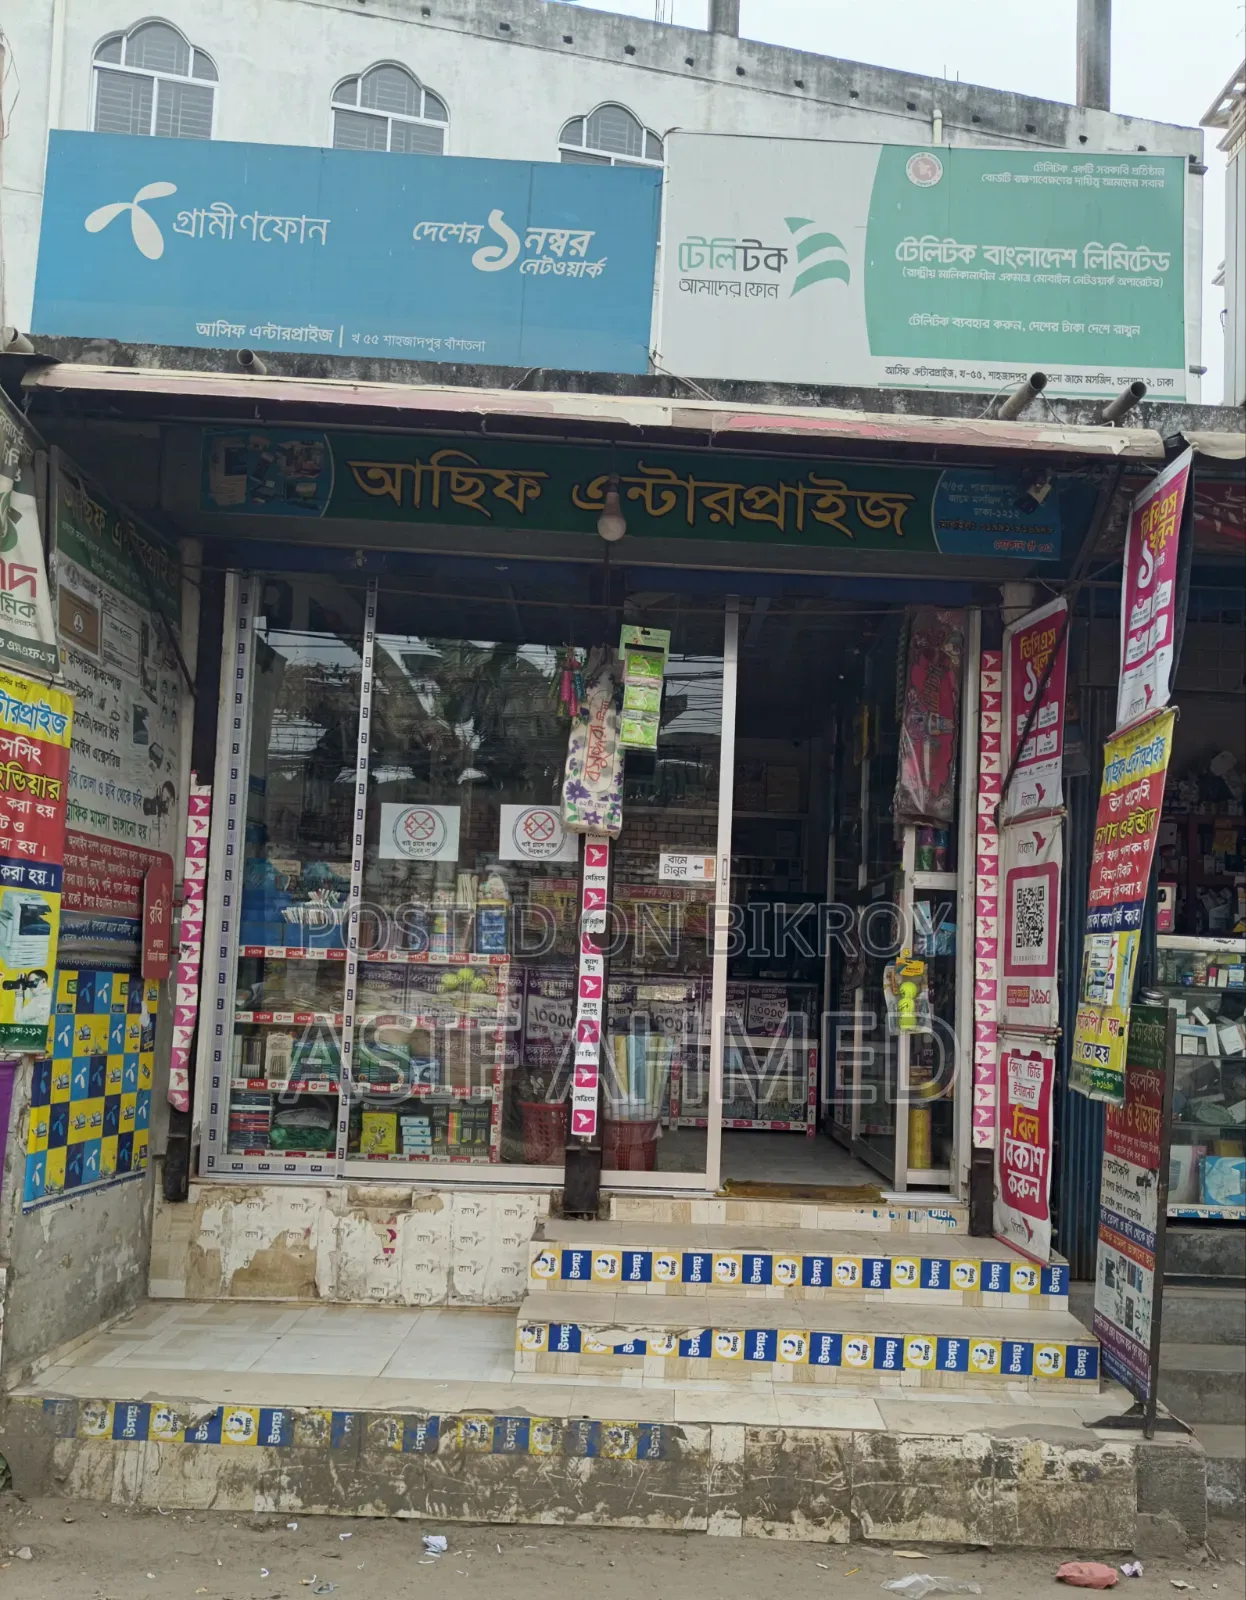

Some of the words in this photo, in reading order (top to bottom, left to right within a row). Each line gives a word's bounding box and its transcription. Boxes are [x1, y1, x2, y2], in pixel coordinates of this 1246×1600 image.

[173, 202, 331, 246] গ্রামীণফোন
[413, 221, 484, 244] দেশের
[472, 209, 520, 272] ১
[525, 227, 595, 258] নম্বর
[520, 256, 607, 278] নেটওয়ার্ক
[678, 236, 788, 274] টেলিটক
[896, 236, 976, 263] টেলিটক
[983, 246, 1077, 272] বাংলাদেশ
[1082, 242, 1170, 277] লিমিটেড
[679, 278, 742, 298] আমাদের
[745, 282, 780, 300] ফোন
[1033, 275, 1070, 286] মোবাইল
[195, 319, 246, 339] আসিফ
[249, 322, 334, 345] এন্টারপ্রাইজ
[382, 335, 442, 353] শাহজাদপুর
[908, 314, 949, 328] টেলিটক
[952, 318, 990, 330] ব্যবহার
[993, 319, 1026, 333] করুন,
[1028, 320, 1059, 333] দেশের
[1061, 320, 1085, 333] টাকা
[1087, 323, 1111, 335] দেশে
[1113, 325, 1141, 339] রাখুন
[885, 363, 910, 375] আসিফ
[1065, 374, 1083, 386] জামে
[1085, 375, 1115, 388] মসজিদ,
[345, 448, 551, 520] আছিফ
[571, 460, 916, 540] এন্টারপ্রাইজ
[1020, 628, 1057, 661] ডিপিএস
[79, 774, 97, 794] তোলা
[105, 780, 116, 801] ছবি
[117, 788, 132, 805] থেকে
[7, 796, 32, 814] করা
[36, 802, 57, 820] হয়
[89, 808, 111, 832] মামলা
[13, 821, 26, 833] ও
[16, 839, 38, 856] হয়
[667, 855, 688, 865] বামে
[0, 864, 25, 883] করা
[28, 867, 48, 886] হয়
[664, 863, 688, 877] টানুন
[149, 898, 163, 925] রবি
[1130, 1069, 1161, 1098] প্রসেসিং
[1012, 1103, 1039, 1145] বিল
[1003, 1128, 1045, 1177] বিকাশ
[1007, 1166, 1040, 1204] করুন
[570, 1253, 584, 1279] উপায়
[630, 1254, 645, 1280] উপায়
[690, 1256, 705, 1283] উপায়
[751, 1257, 766, 1283] উপায়
[811, 1259, 826, 1285] উপায়
[870, 1261, 885, 1287] উপায়
[929, 1261, 944, 1287] উপায়
[990, 1263, 1004, 1290] উপায়
[1050, 1266, 1064, 1293] উপায়
[753, 1331, 769, 1359] উপায়
[819, 1336, 834, 1364] উপায়
[884, 1340, 899, 1367] উপায়
[945, 1340, 960, 1368] উপায়
[1011, 1344, 1026, 1372] উপায়
[1075, 1348, 1090, 1376] উপায়
